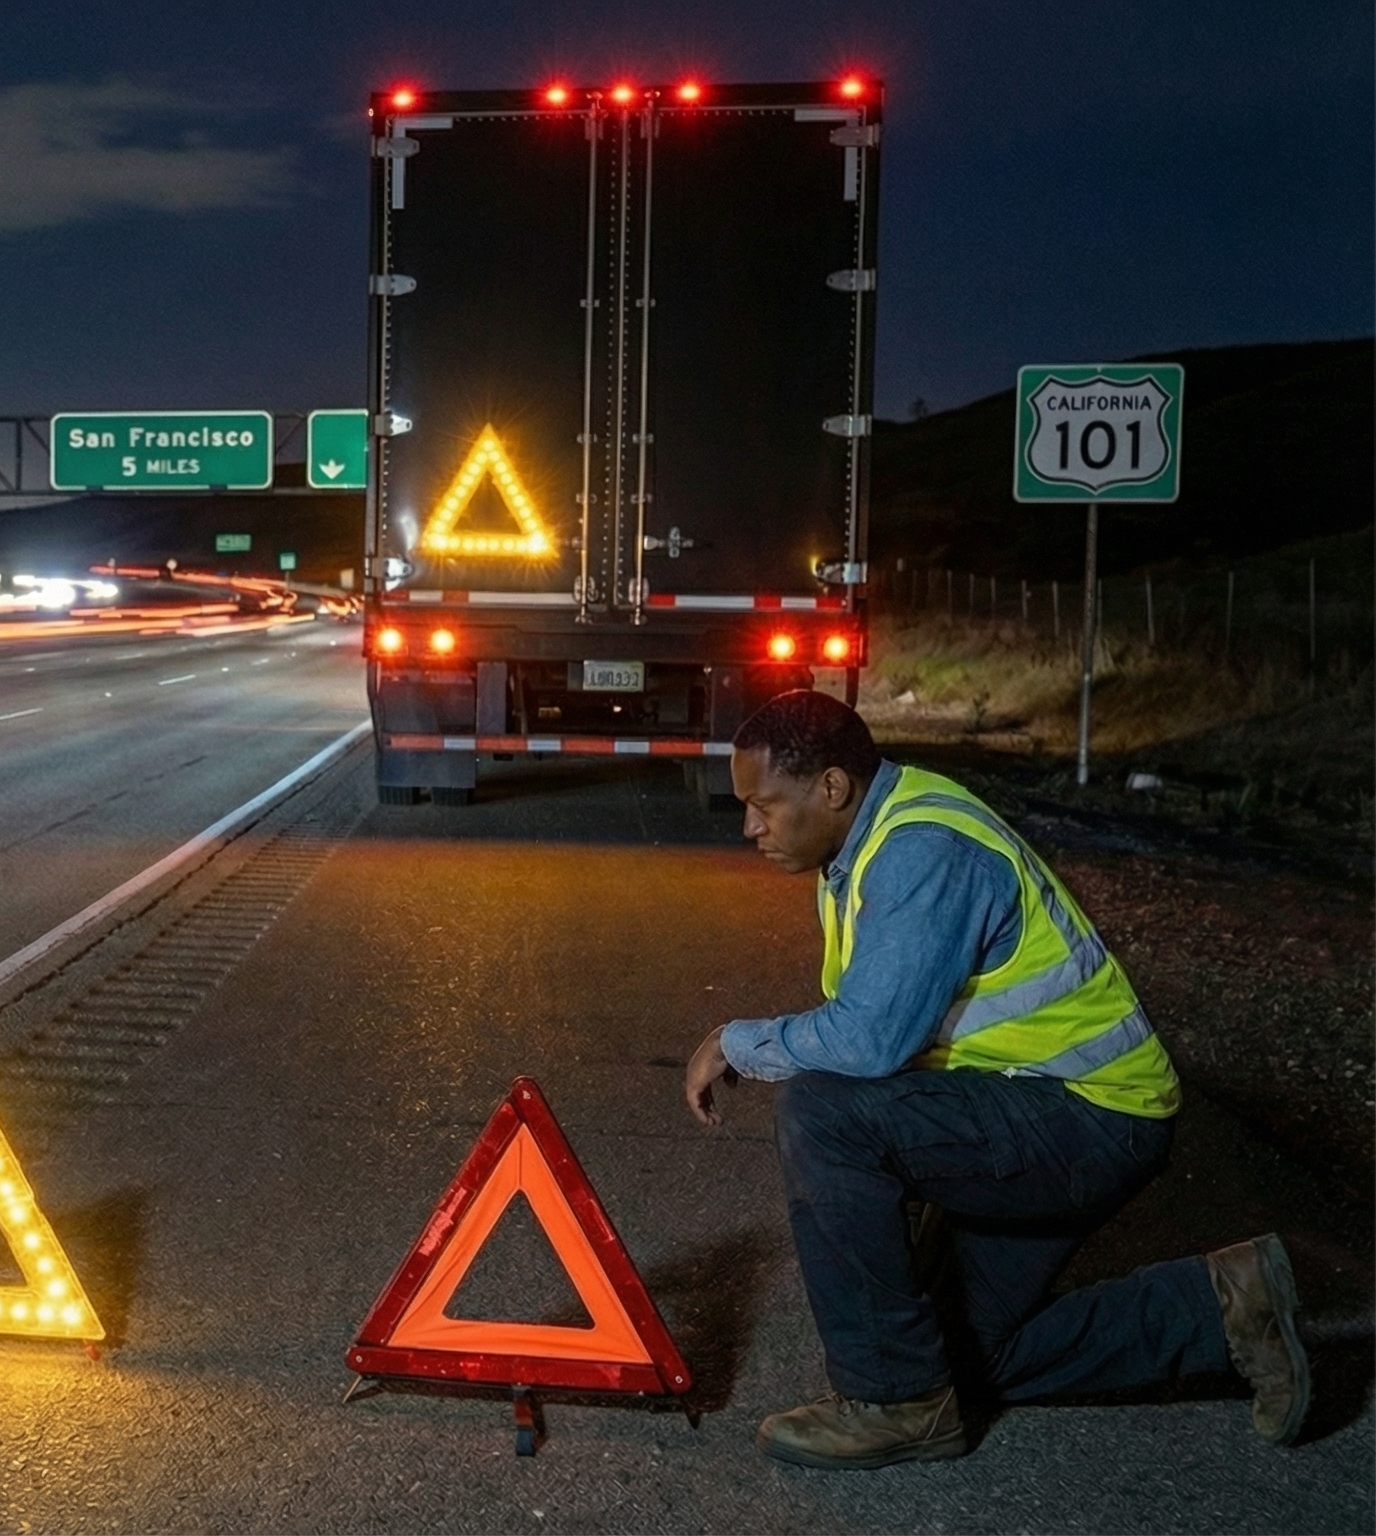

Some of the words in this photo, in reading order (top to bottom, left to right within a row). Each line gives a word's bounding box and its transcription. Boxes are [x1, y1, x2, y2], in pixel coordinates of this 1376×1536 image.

[1046, 395, 1152, 411] CALIFORNIA
[69, 428, 115, 448] San
[129, 427, 254, 447] Francisco
[1055, 419, 1142, 471] 101
[122, 456, 137, 477] 5
[146, 459, 201, 474] MILES
